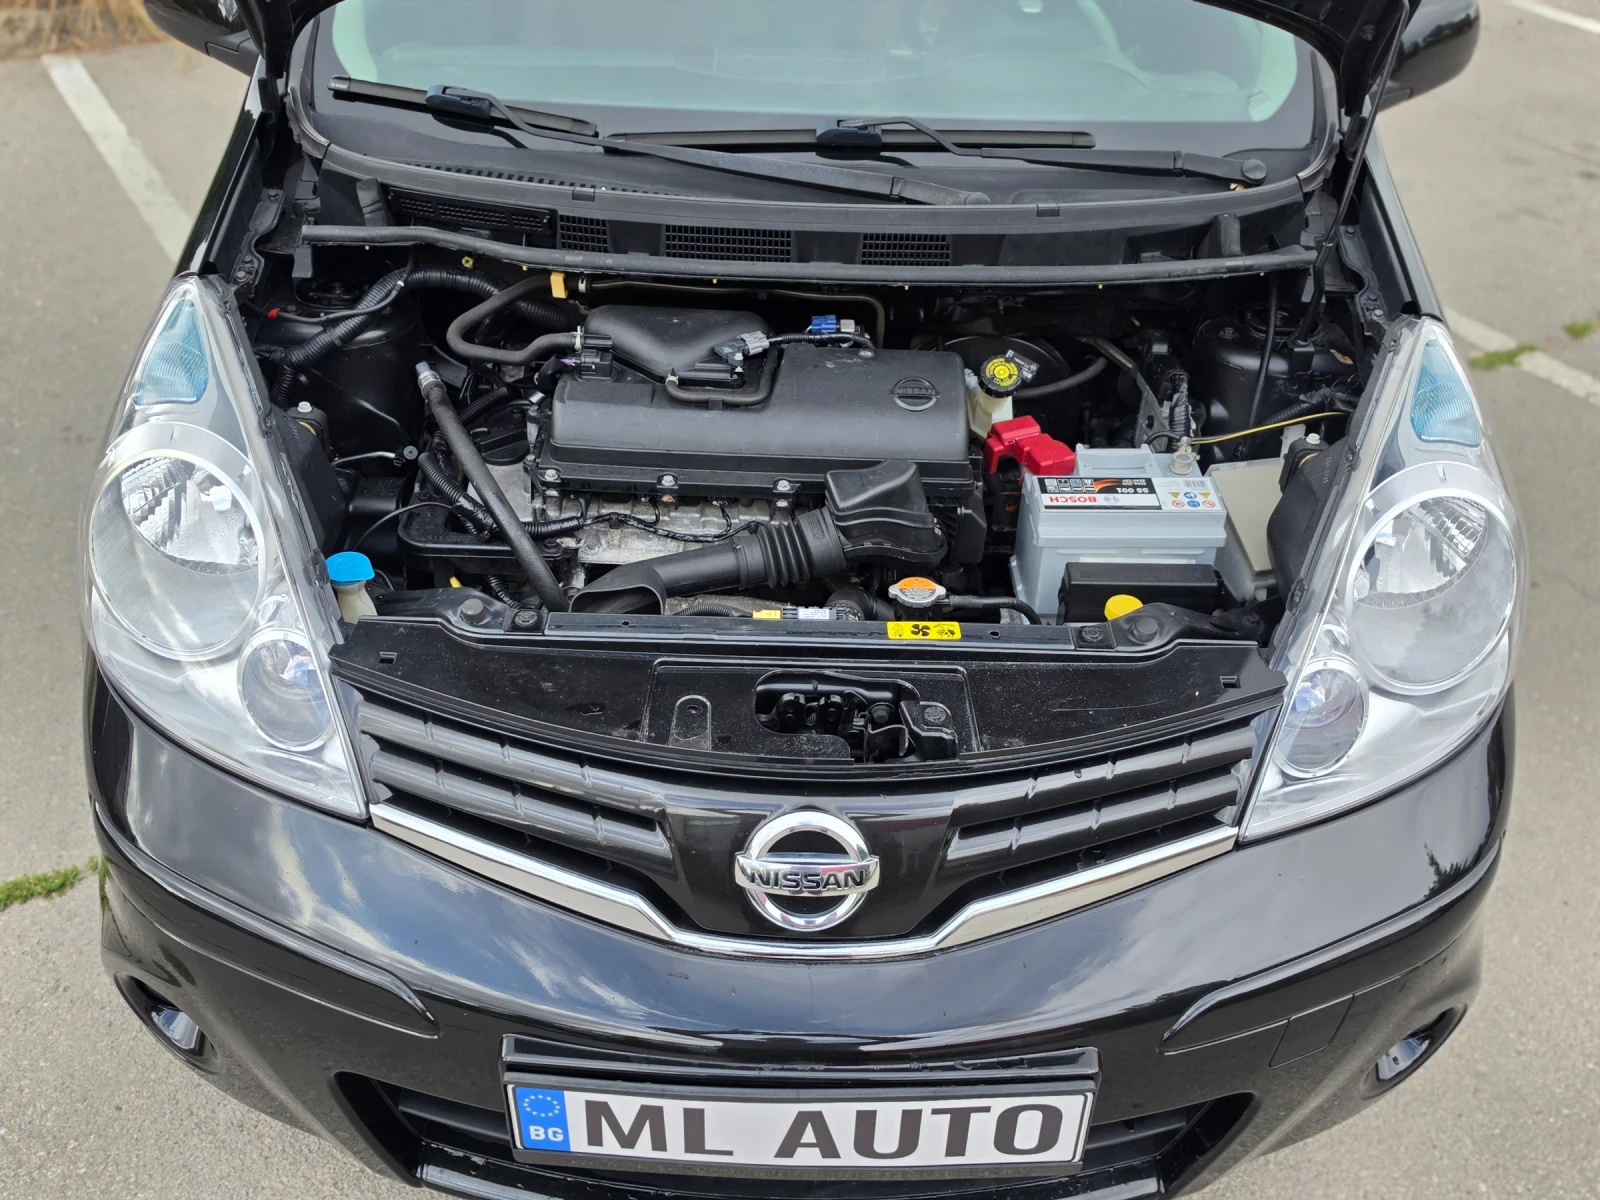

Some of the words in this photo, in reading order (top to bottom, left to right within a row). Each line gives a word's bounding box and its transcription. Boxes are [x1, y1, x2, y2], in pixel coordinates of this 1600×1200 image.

[894, 386, 936, 397] NISSAN
[1049, 496, 1097, 504] BOSCH
[749, 868, 865, 891] NISSAN
[528, 1125, 564, 1143] BG
[585, 1099, 734, 1157] ML
[774, 1103, 1064, 1161] AUTO
